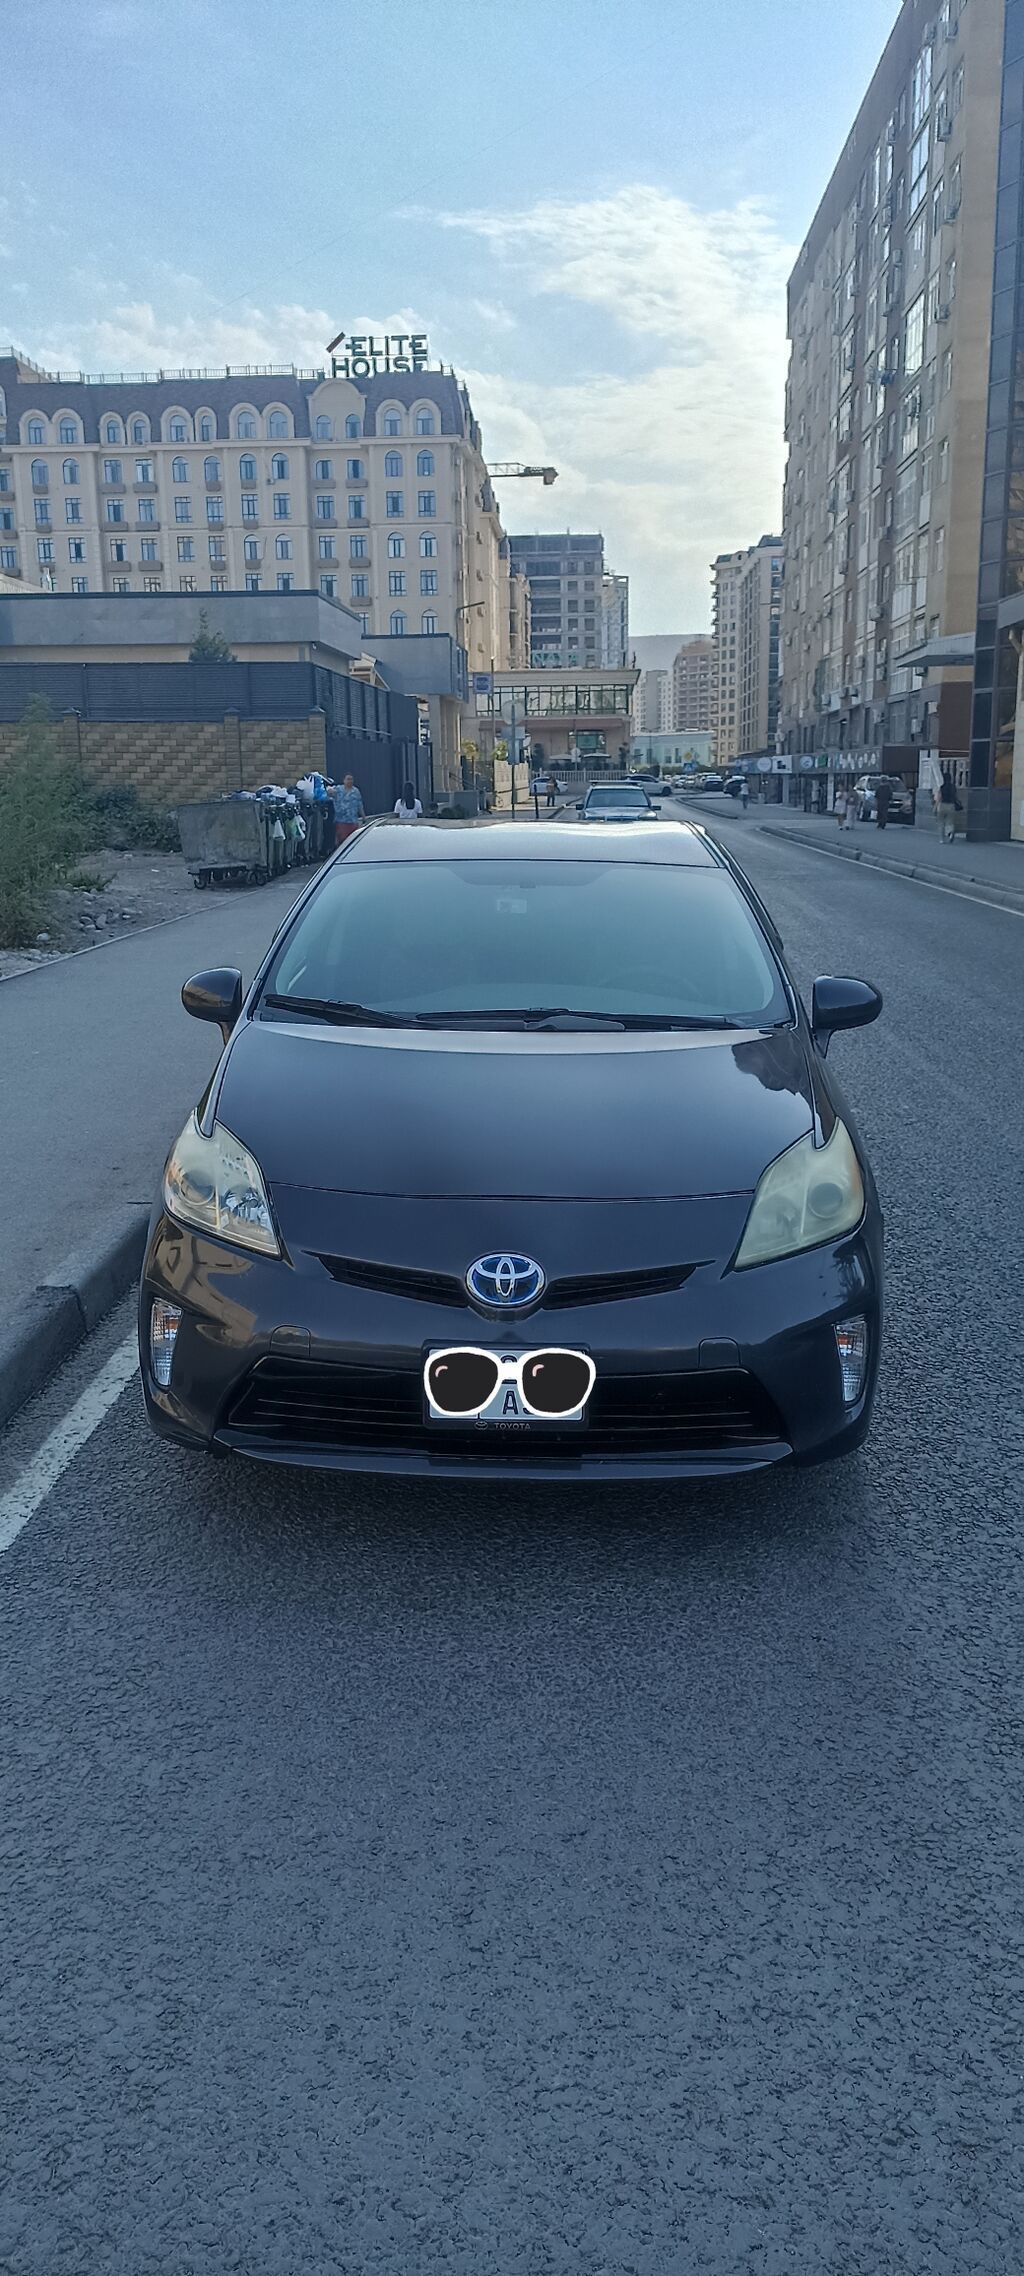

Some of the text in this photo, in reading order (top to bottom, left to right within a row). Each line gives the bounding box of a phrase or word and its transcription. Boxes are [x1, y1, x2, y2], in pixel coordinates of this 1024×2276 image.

[345, 334, 428, 357] ELITE
[331, 356, 428, 378] HOUSE
[494, 1422, 531, 1430] TOYOTA
